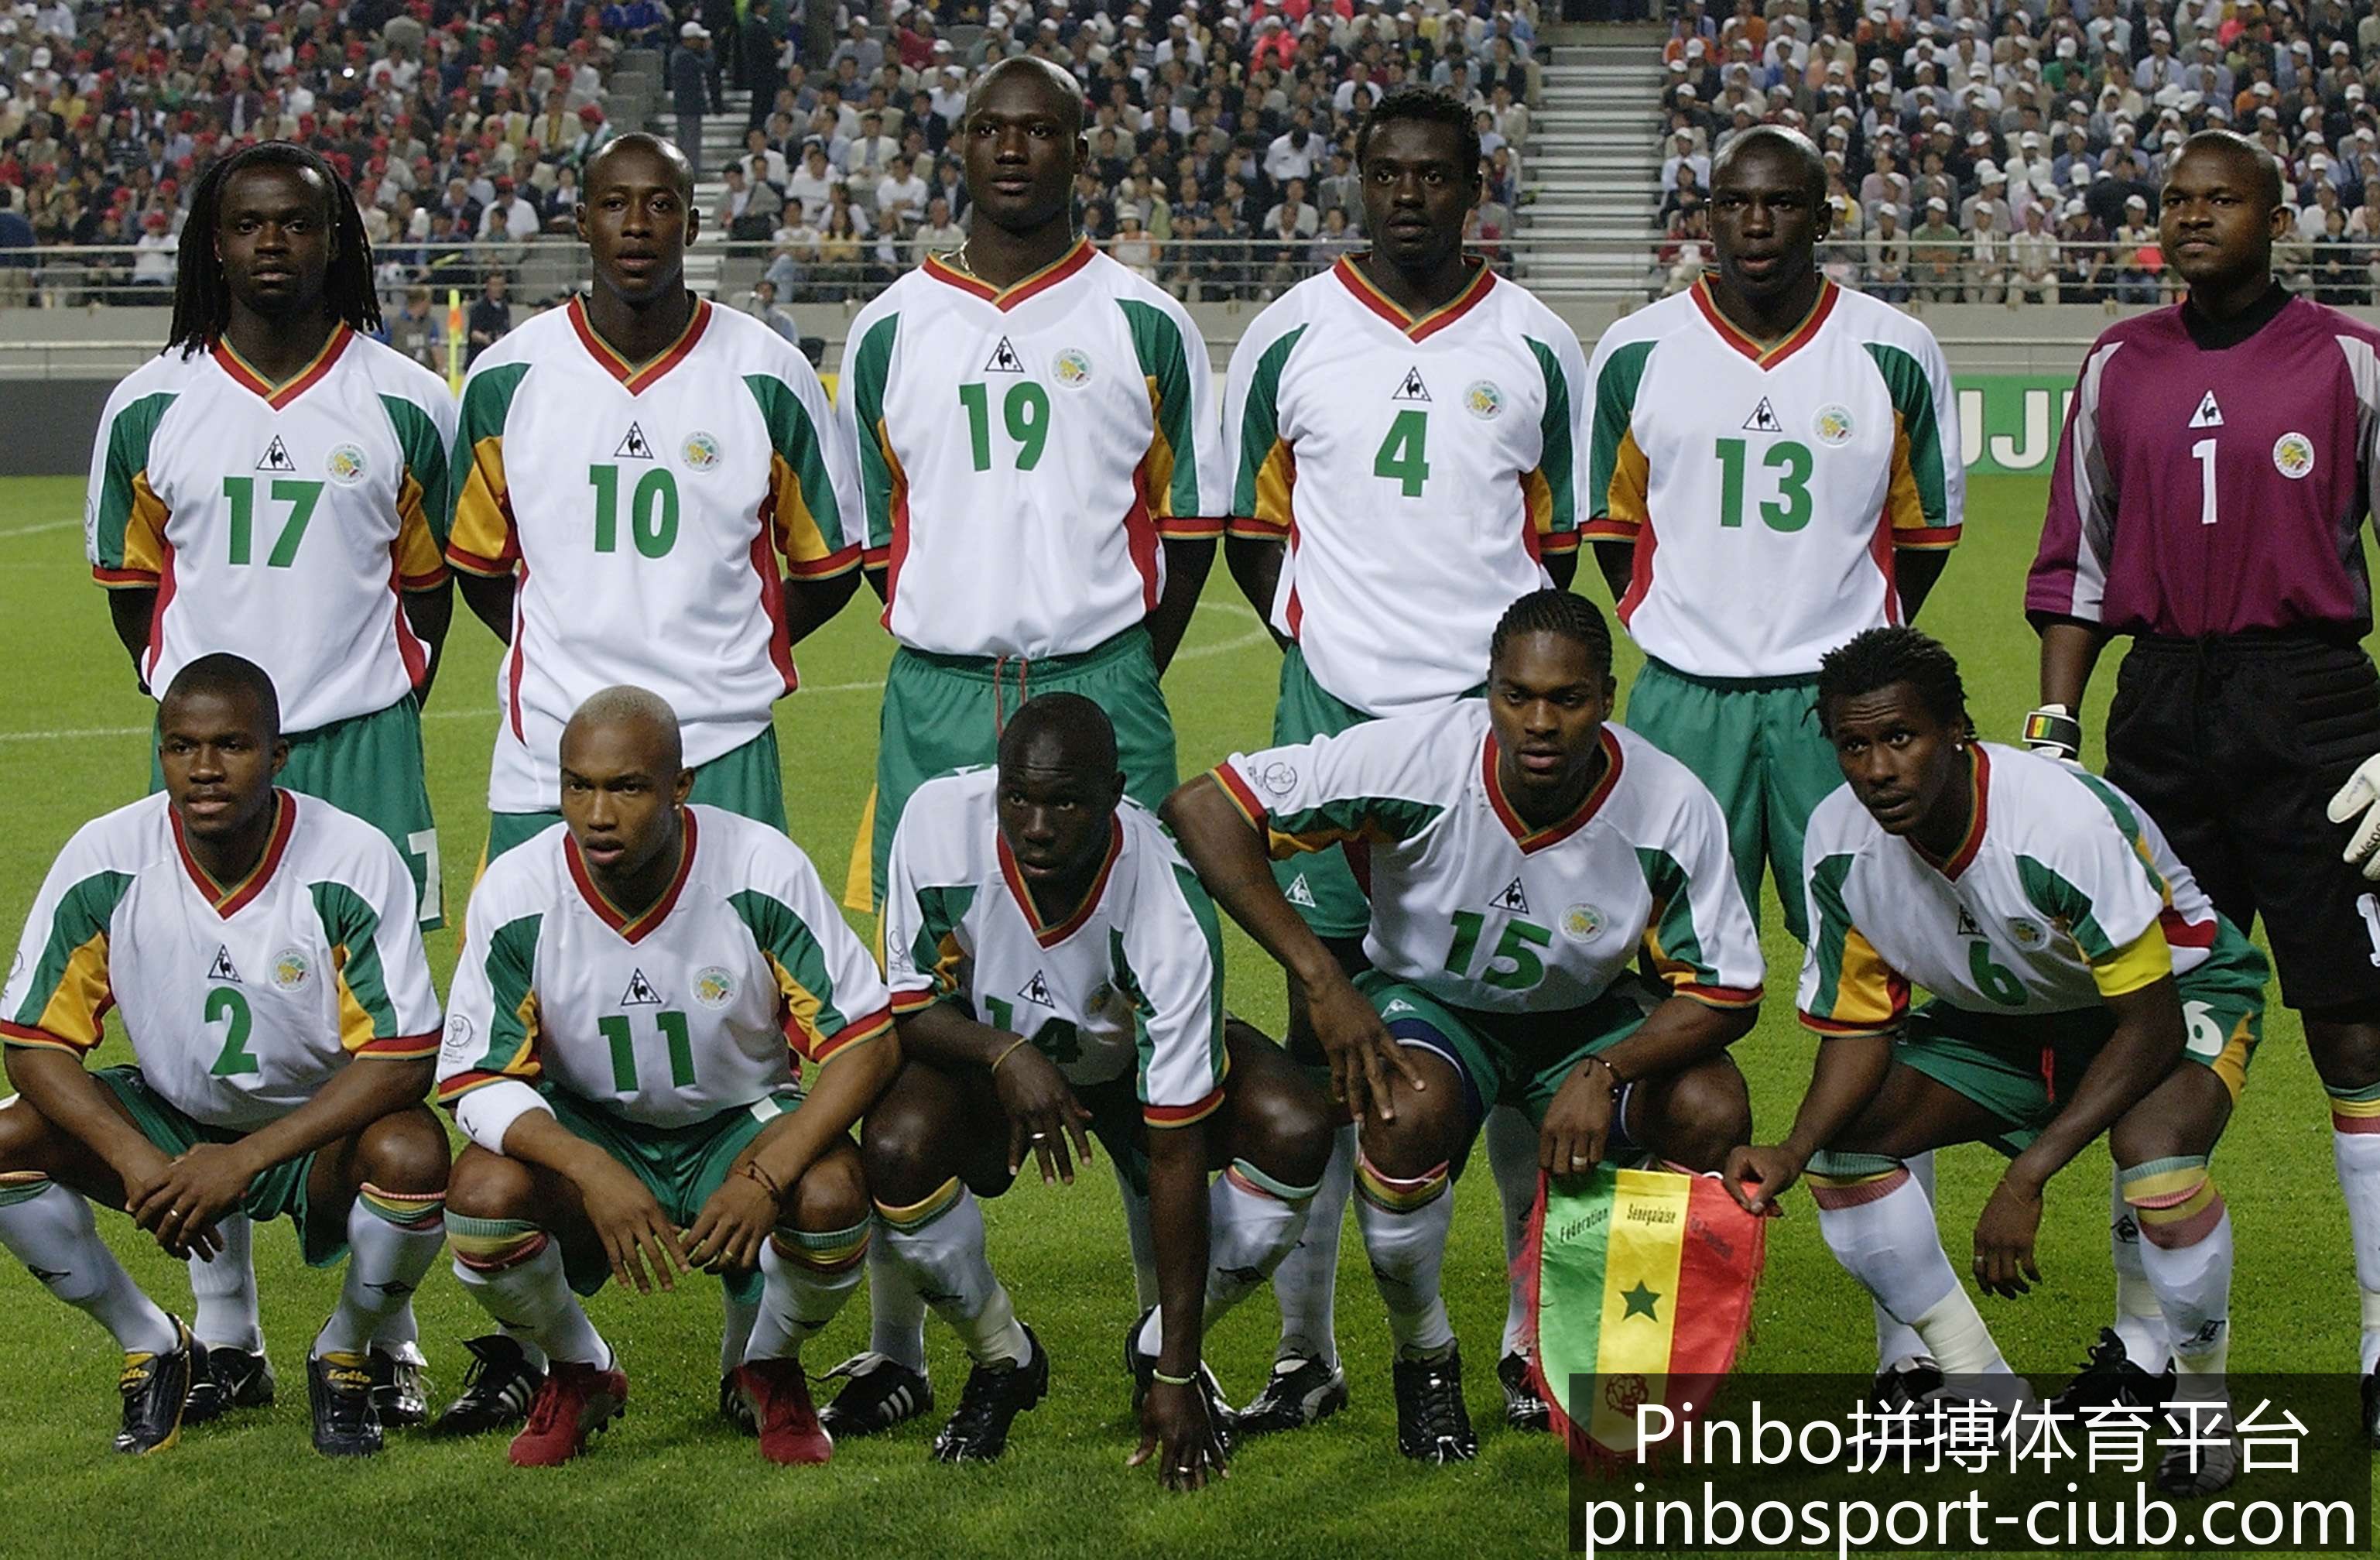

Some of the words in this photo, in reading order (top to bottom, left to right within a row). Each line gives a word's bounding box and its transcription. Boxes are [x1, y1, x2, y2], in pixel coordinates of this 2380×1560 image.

[958, 380, 1050, 472] 19
[1374, 409, 1430, 498] 4
[222, 476, 324, 568] 17
[588, 464, 680, 559] 10
[1715, 437, 1813, 533] 13
[2191, 437, 2218, 525] 1
[1443, 910, 1553, 991] 15
[1967, 940, 2029, 1006] 6
[204, 986, 261, 1077] 2
[598, 1010, 697, 1092] 11
[2182, 999, 2224, 1057] 6
